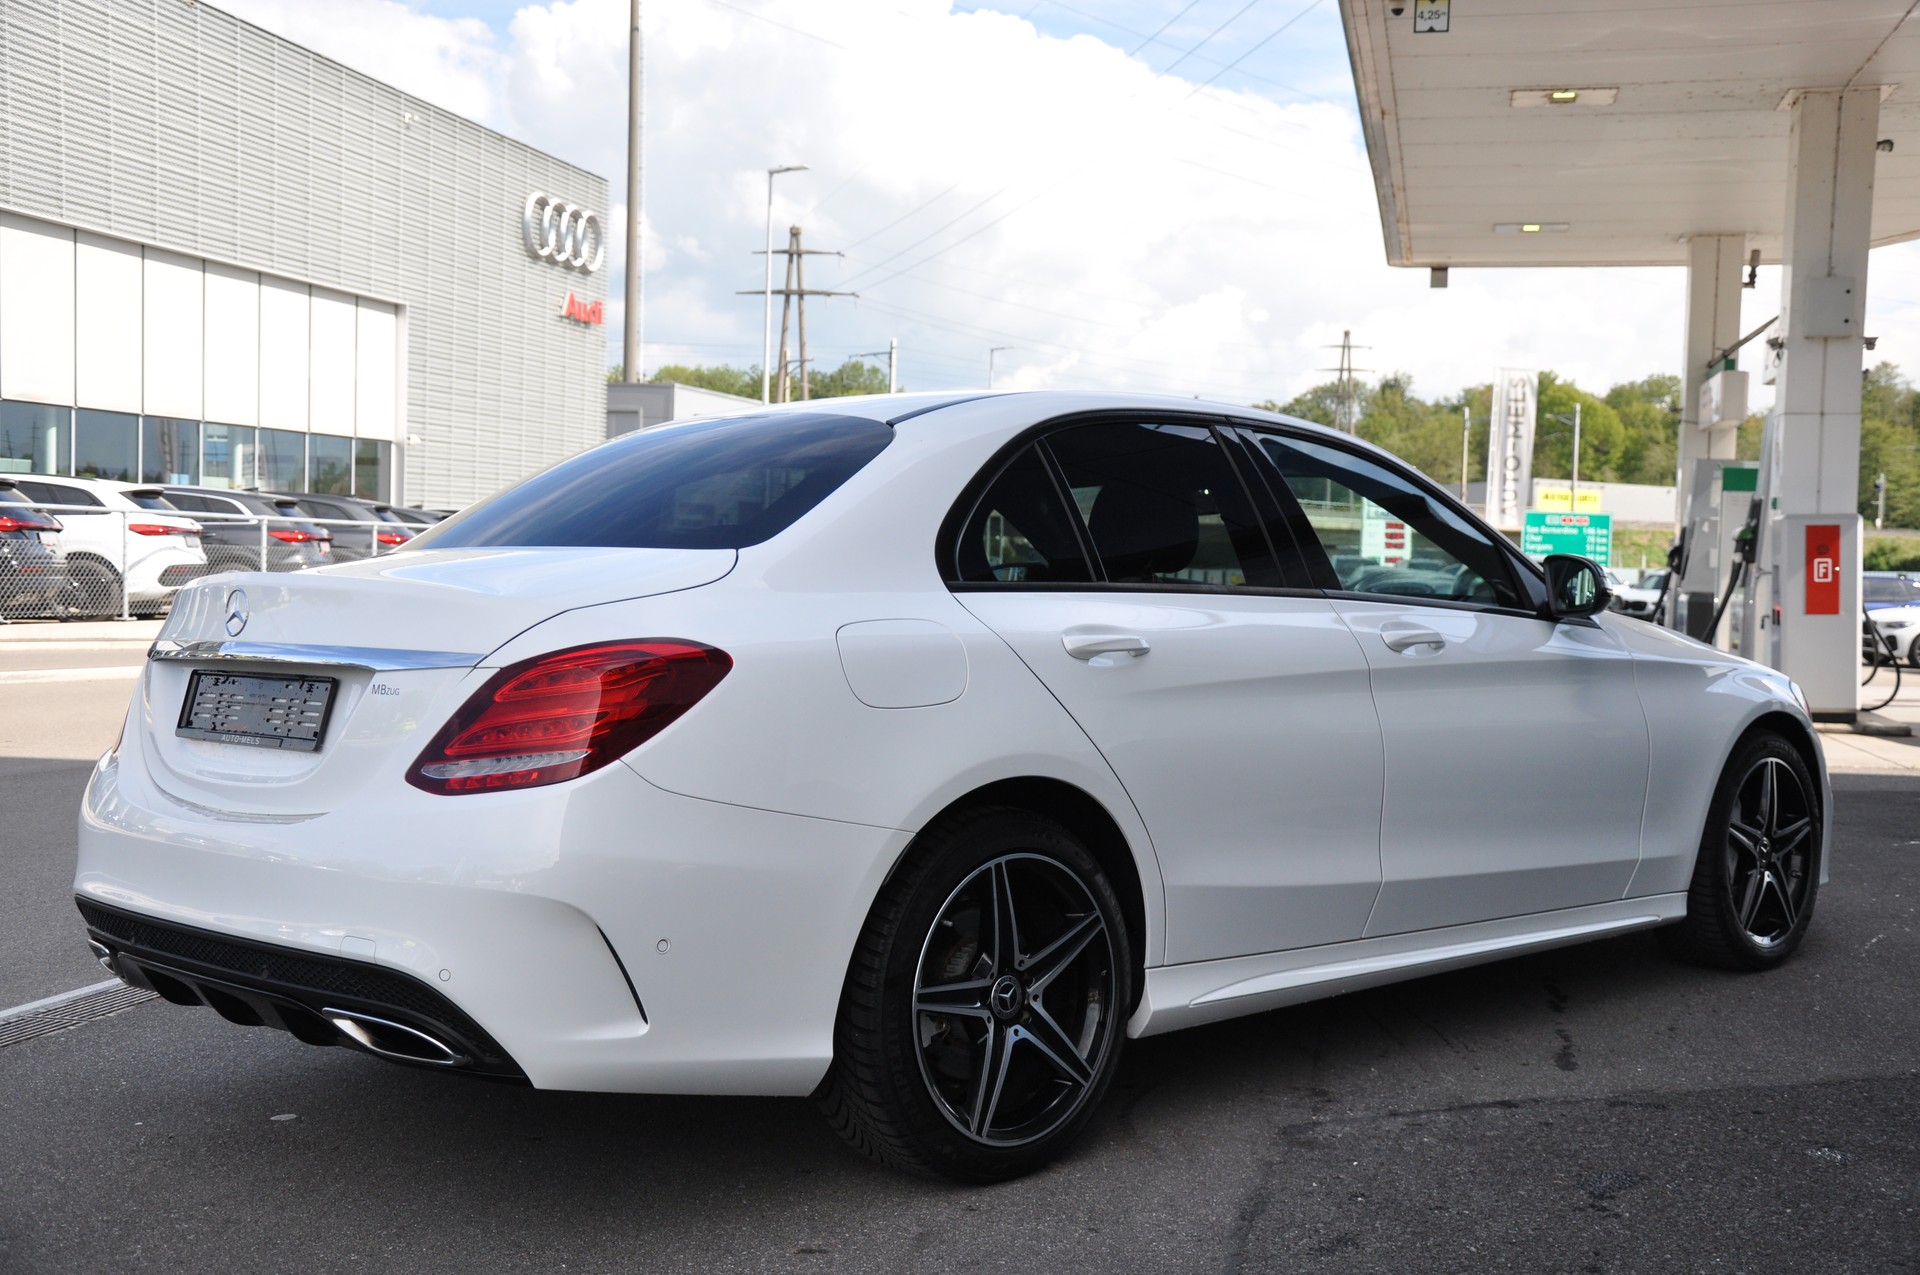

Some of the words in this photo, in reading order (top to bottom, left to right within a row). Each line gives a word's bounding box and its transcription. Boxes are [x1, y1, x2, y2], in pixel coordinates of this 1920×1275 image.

[563, 291, 604, 325] Audi
[1501, 377, 1528, 518] AUTO-MELS
[1540, 525, 1579, 535] Bernardino
